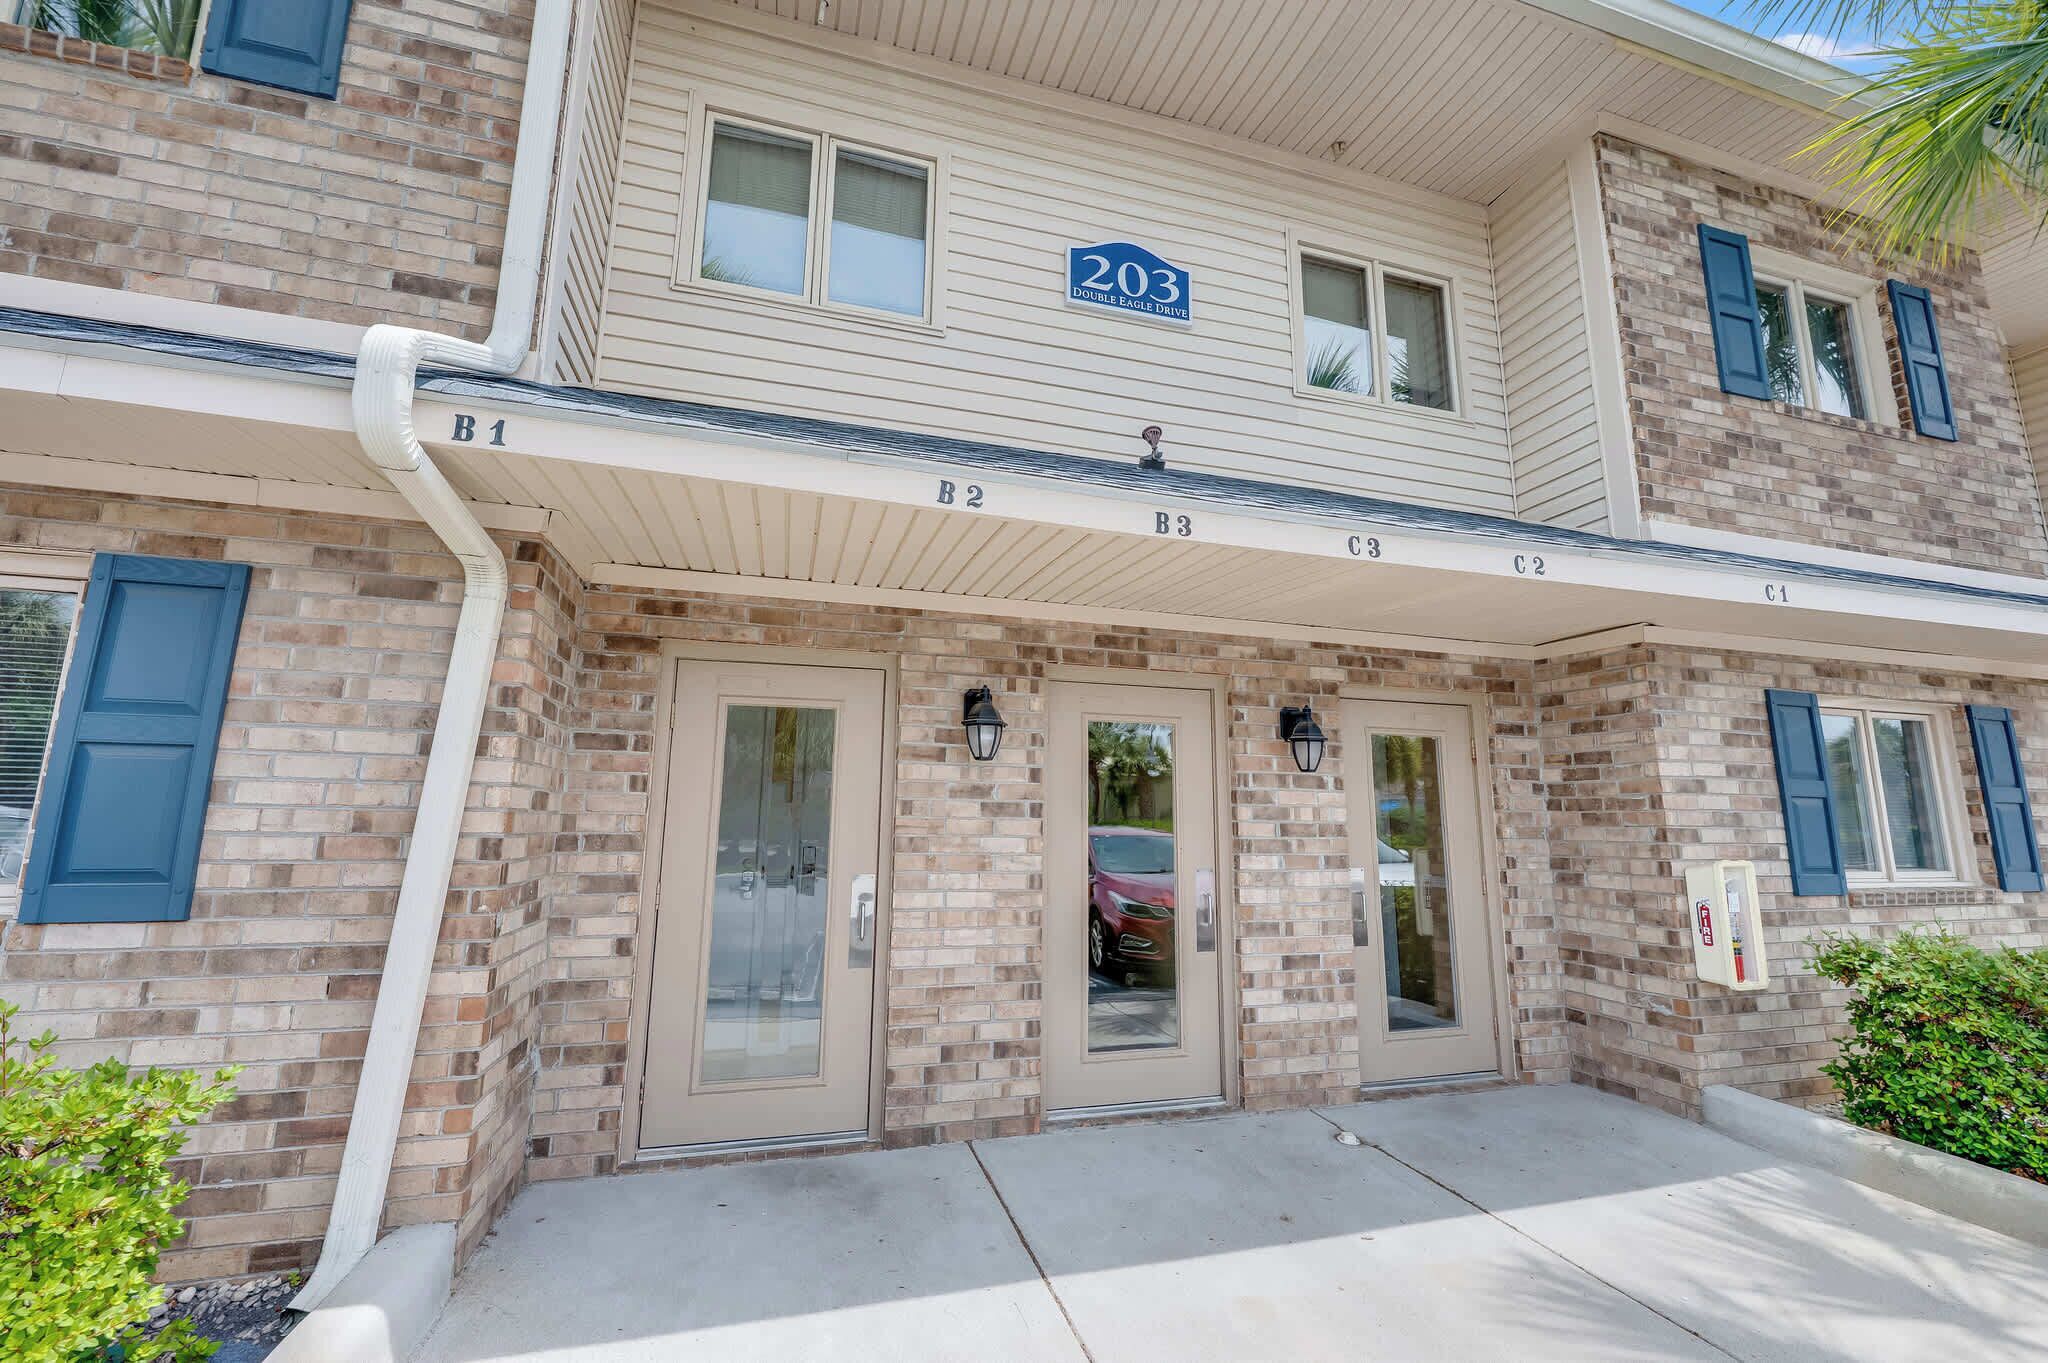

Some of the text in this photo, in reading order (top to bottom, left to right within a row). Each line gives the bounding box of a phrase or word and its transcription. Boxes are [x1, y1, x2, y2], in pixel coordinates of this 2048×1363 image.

[1080, 254, 1180, 303] 203
[1072, 287, 1188, 318] DOUBLE EAGLE DRIVE
[1701, 910, 1712, 944] FIRE
